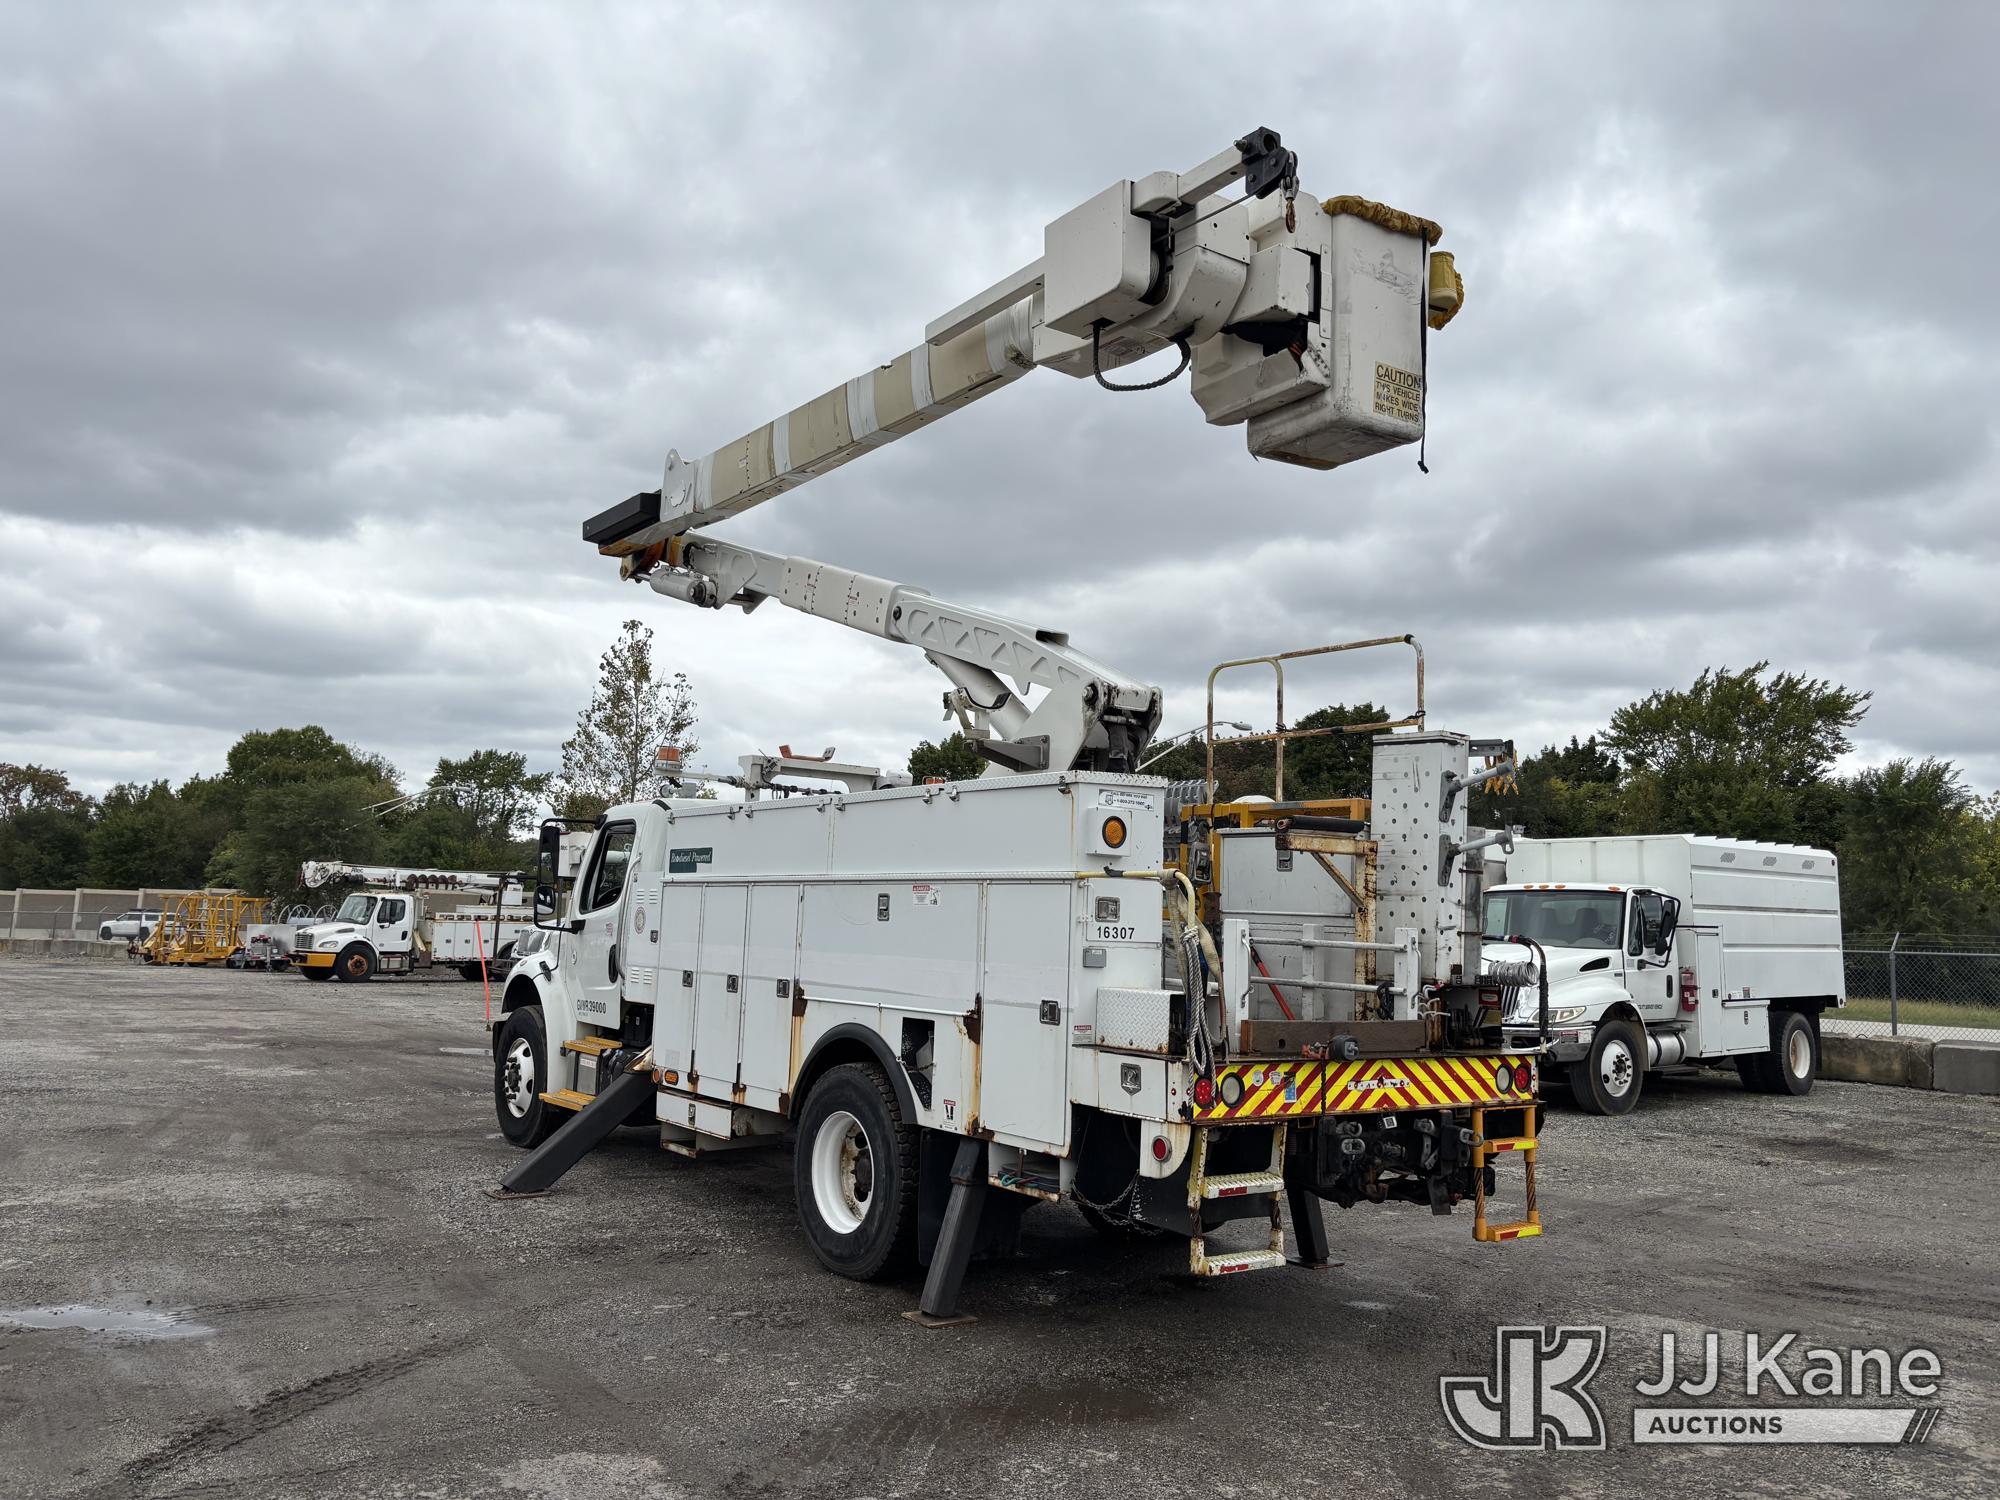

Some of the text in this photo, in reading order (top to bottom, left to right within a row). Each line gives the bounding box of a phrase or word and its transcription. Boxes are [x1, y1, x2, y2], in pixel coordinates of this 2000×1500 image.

[1376, 364, 1421, 388] CAUTION
[1376, 392, 1419, 411] MAKES WIDE
[1393, 386, 1420, 401] VEHICLE
[1375, 402, 1419, 422] RIGHT TURNS
[1097, 926, 1135, 940] 16307
